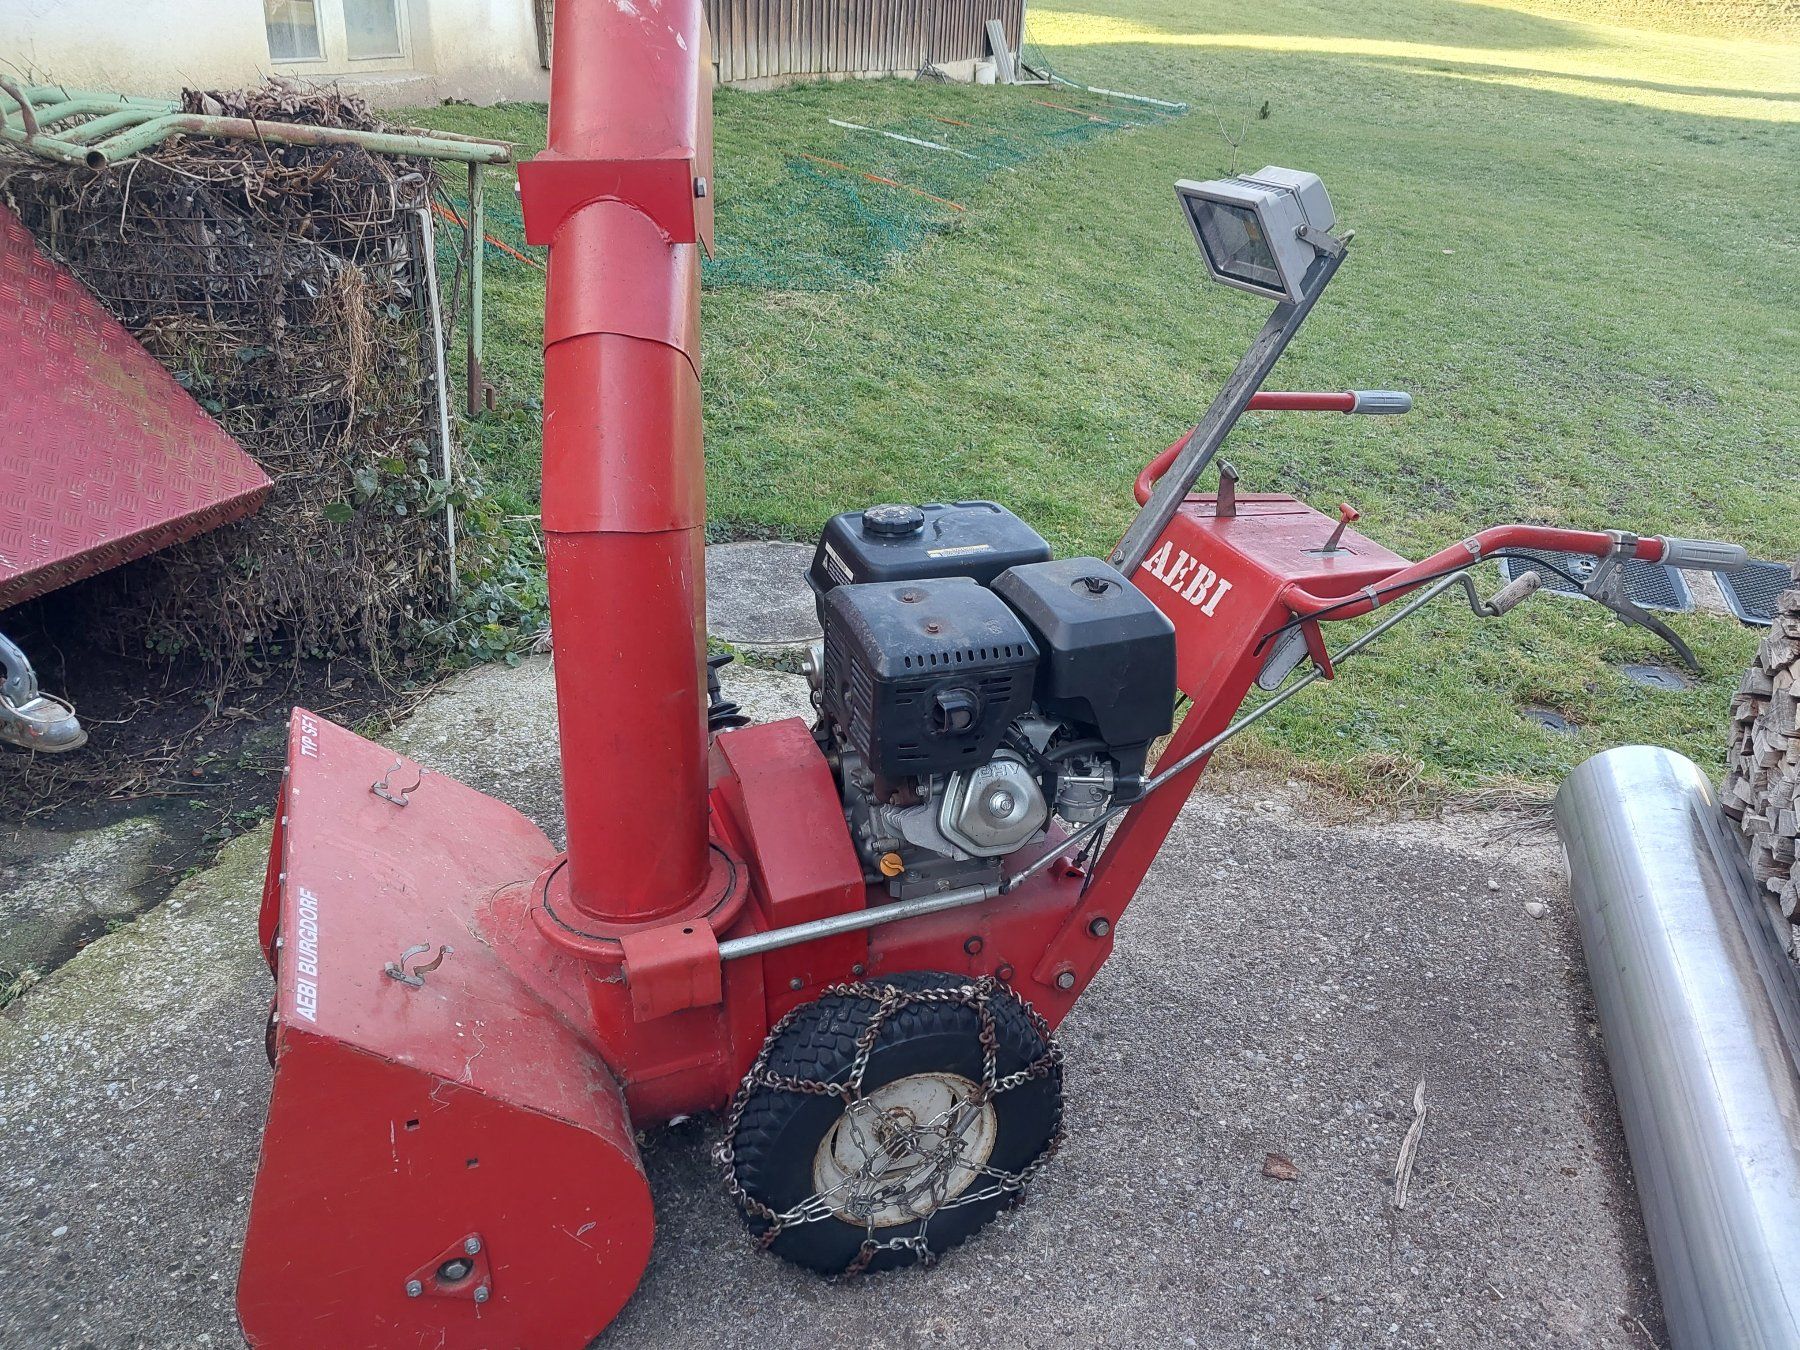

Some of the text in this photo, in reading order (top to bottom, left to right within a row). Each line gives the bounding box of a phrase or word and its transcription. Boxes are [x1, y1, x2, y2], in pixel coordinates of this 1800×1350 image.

[1141, 541, 1232, 617] AEBI
[301, 714, 317, 758] TYP SF1
[296, 887, 318, 1022] AEBI BURGDORF
